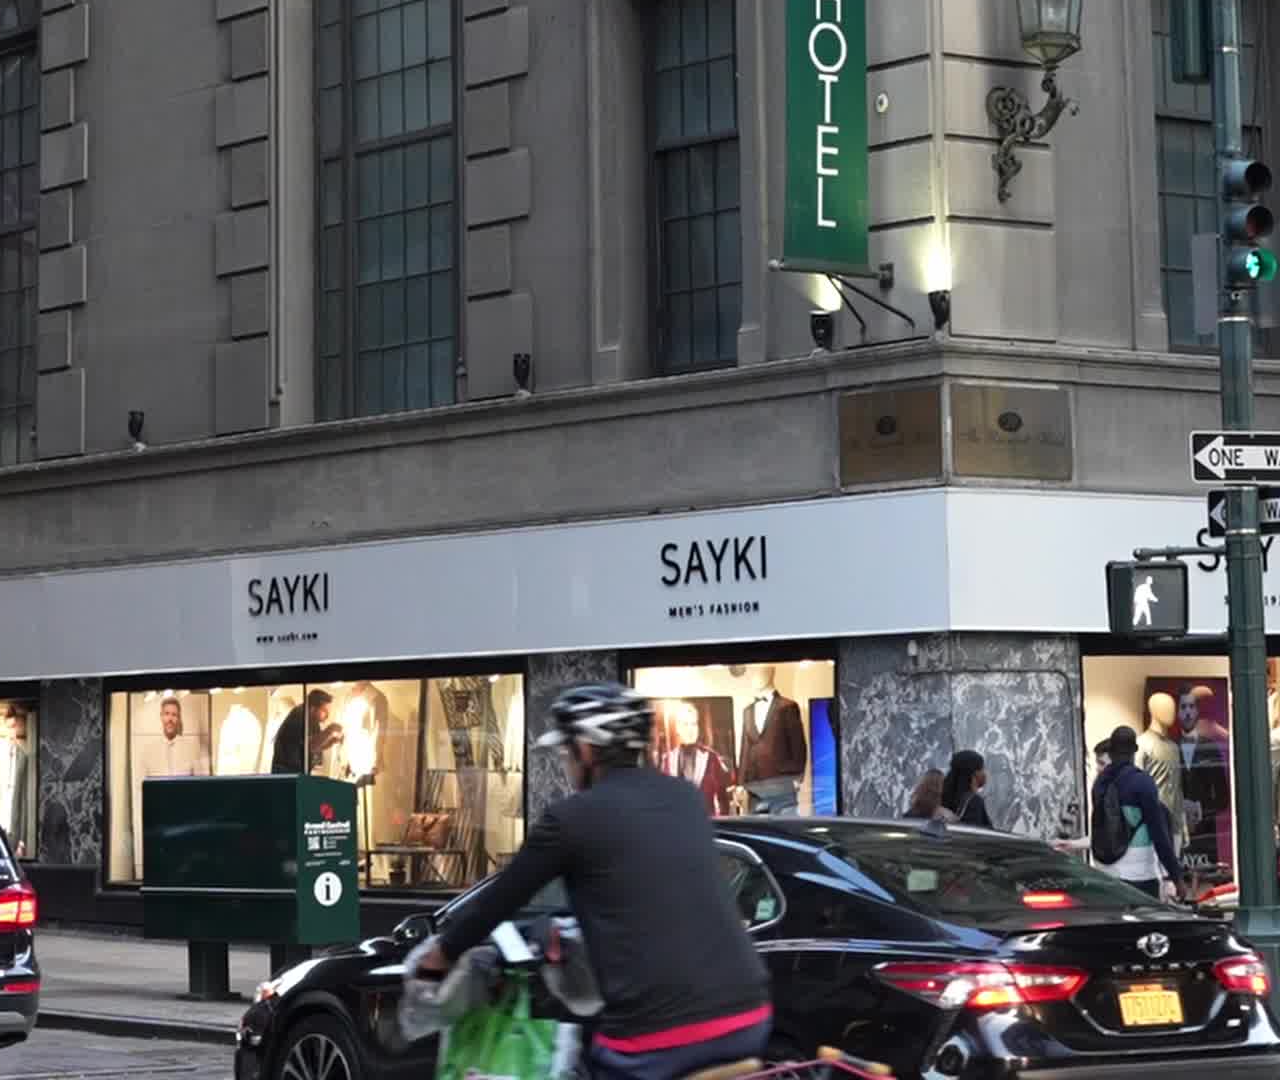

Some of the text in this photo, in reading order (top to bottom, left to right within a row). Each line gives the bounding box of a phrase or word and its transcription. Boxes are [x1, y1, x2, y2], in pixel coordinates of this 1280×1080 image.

[1208, 448, 1245, 467] ONE
[661, 535, 768, 587] SAYKI
[248, 572, 329, 617] SAYKI
[668, 601, 760, 617] MEN'S FASHION
